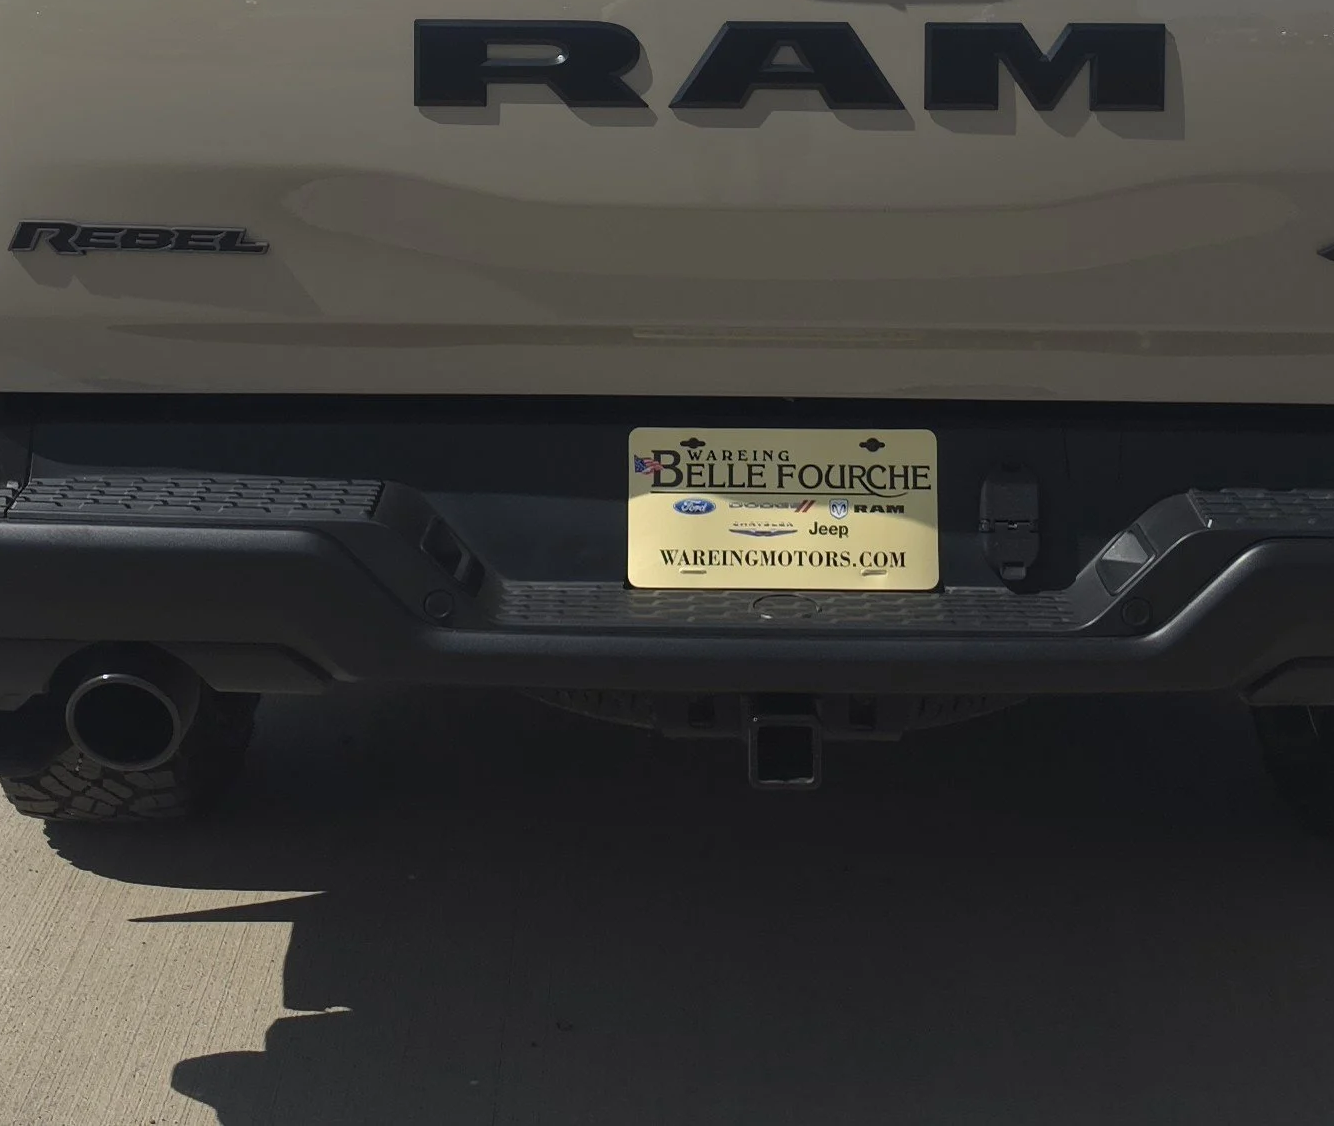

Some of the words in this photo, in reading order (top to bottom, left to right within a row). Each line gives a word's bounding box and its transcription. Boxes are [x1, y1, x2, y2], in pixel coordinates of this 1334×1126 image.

[414, 18, 1166, 110] RAM
[8, 219, 270, 255] REBEL
[687, 450, 790, 462] WAREING
[651, 449, 766, 489] BELLE
[776, 463, 931, 497] FOURCHE
[853, 504, 905, 514] RAM
[808, 522, 849, 538] Jeep
[659, 549, 906, 568] WAREINGMOTORS.COM
